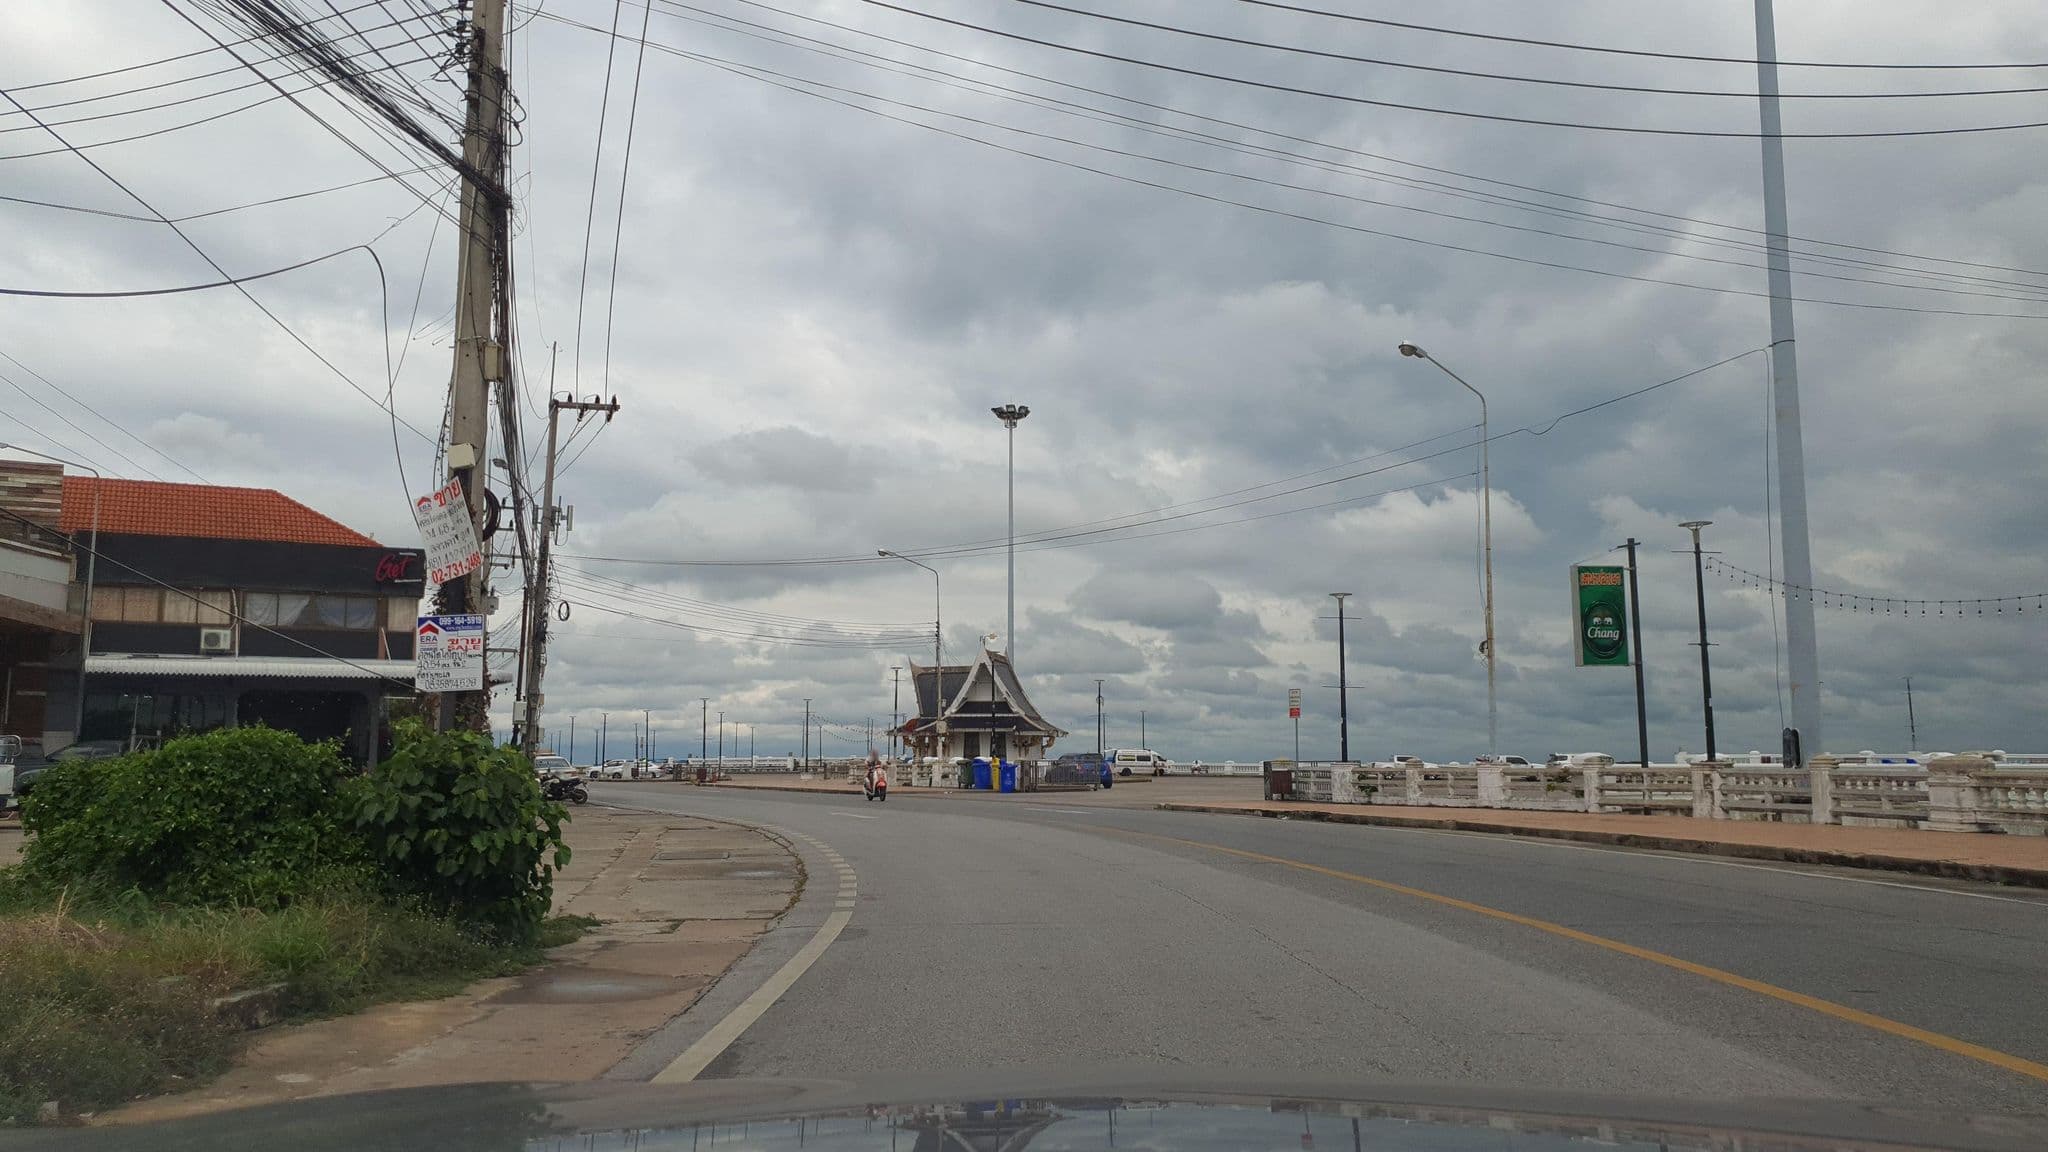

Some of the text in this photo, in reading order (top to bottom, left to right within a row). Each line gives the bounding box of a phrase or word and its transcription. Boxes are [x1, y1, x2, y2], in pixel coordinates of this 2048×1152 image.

[434, 480, 460, 508] ขาย
[420, 635, 438, 643] ERA
[1587, 626, 1620, 640] Chang
